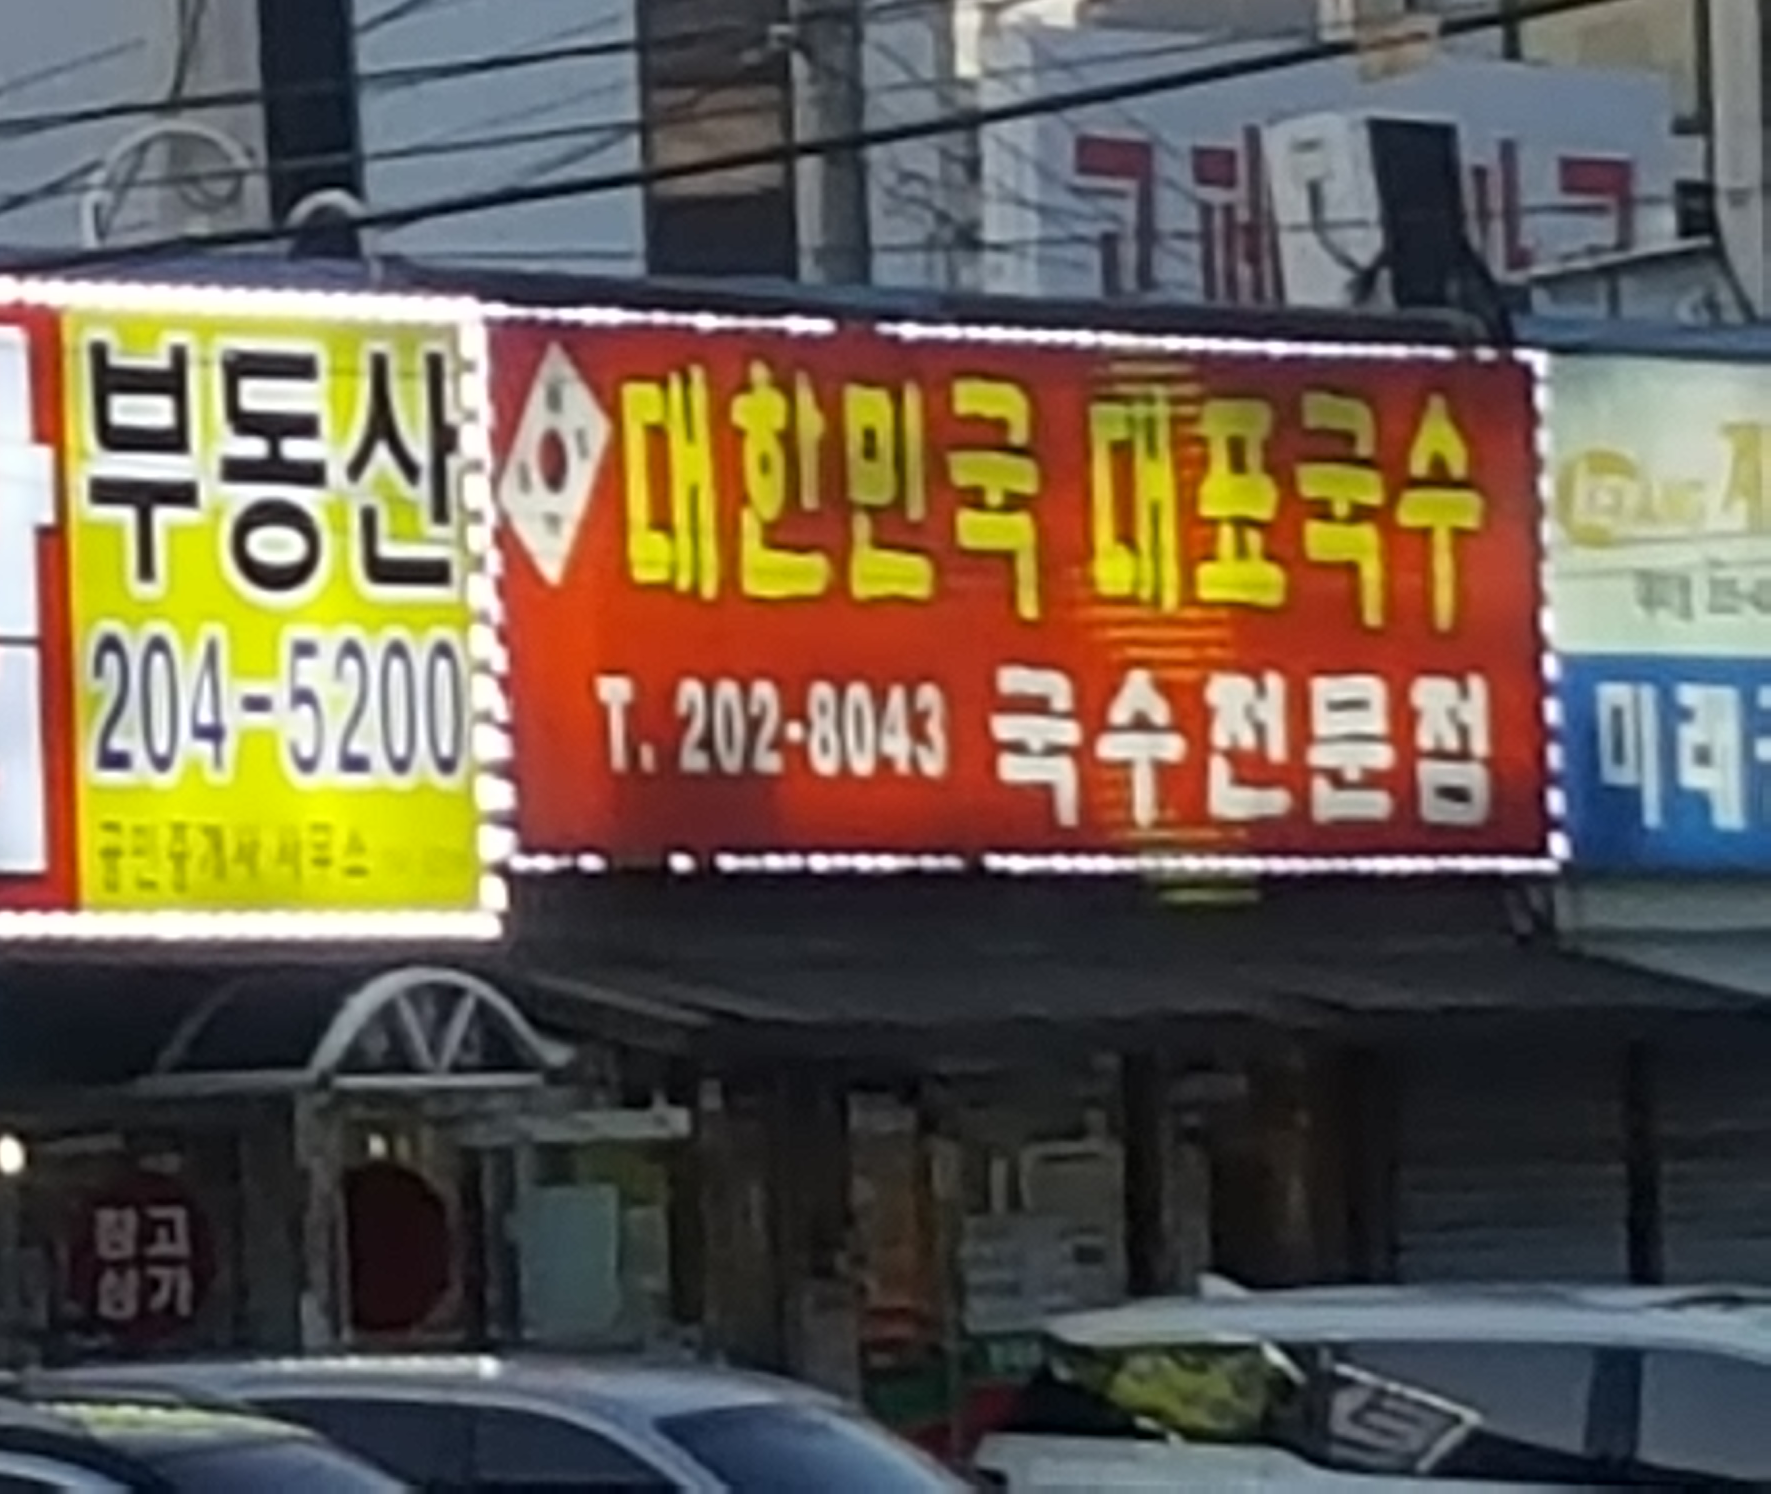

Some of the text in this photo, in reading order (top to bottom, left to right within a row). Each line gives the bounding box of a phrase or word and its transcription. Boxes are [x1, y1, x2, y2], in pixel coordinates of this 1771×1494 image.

[85, 338, 461, 593] 부동산
[619, 358, 1044, 622] 대한민국
[1087, 386, 1486, 633] 대표국수
[90, 631, 461, 777] 204-5200
[675, 676, 948, 779] 202-8043
[988, 662, 1492, 830] 국수전문점
[1596, 682, 1771, 831] 미래
